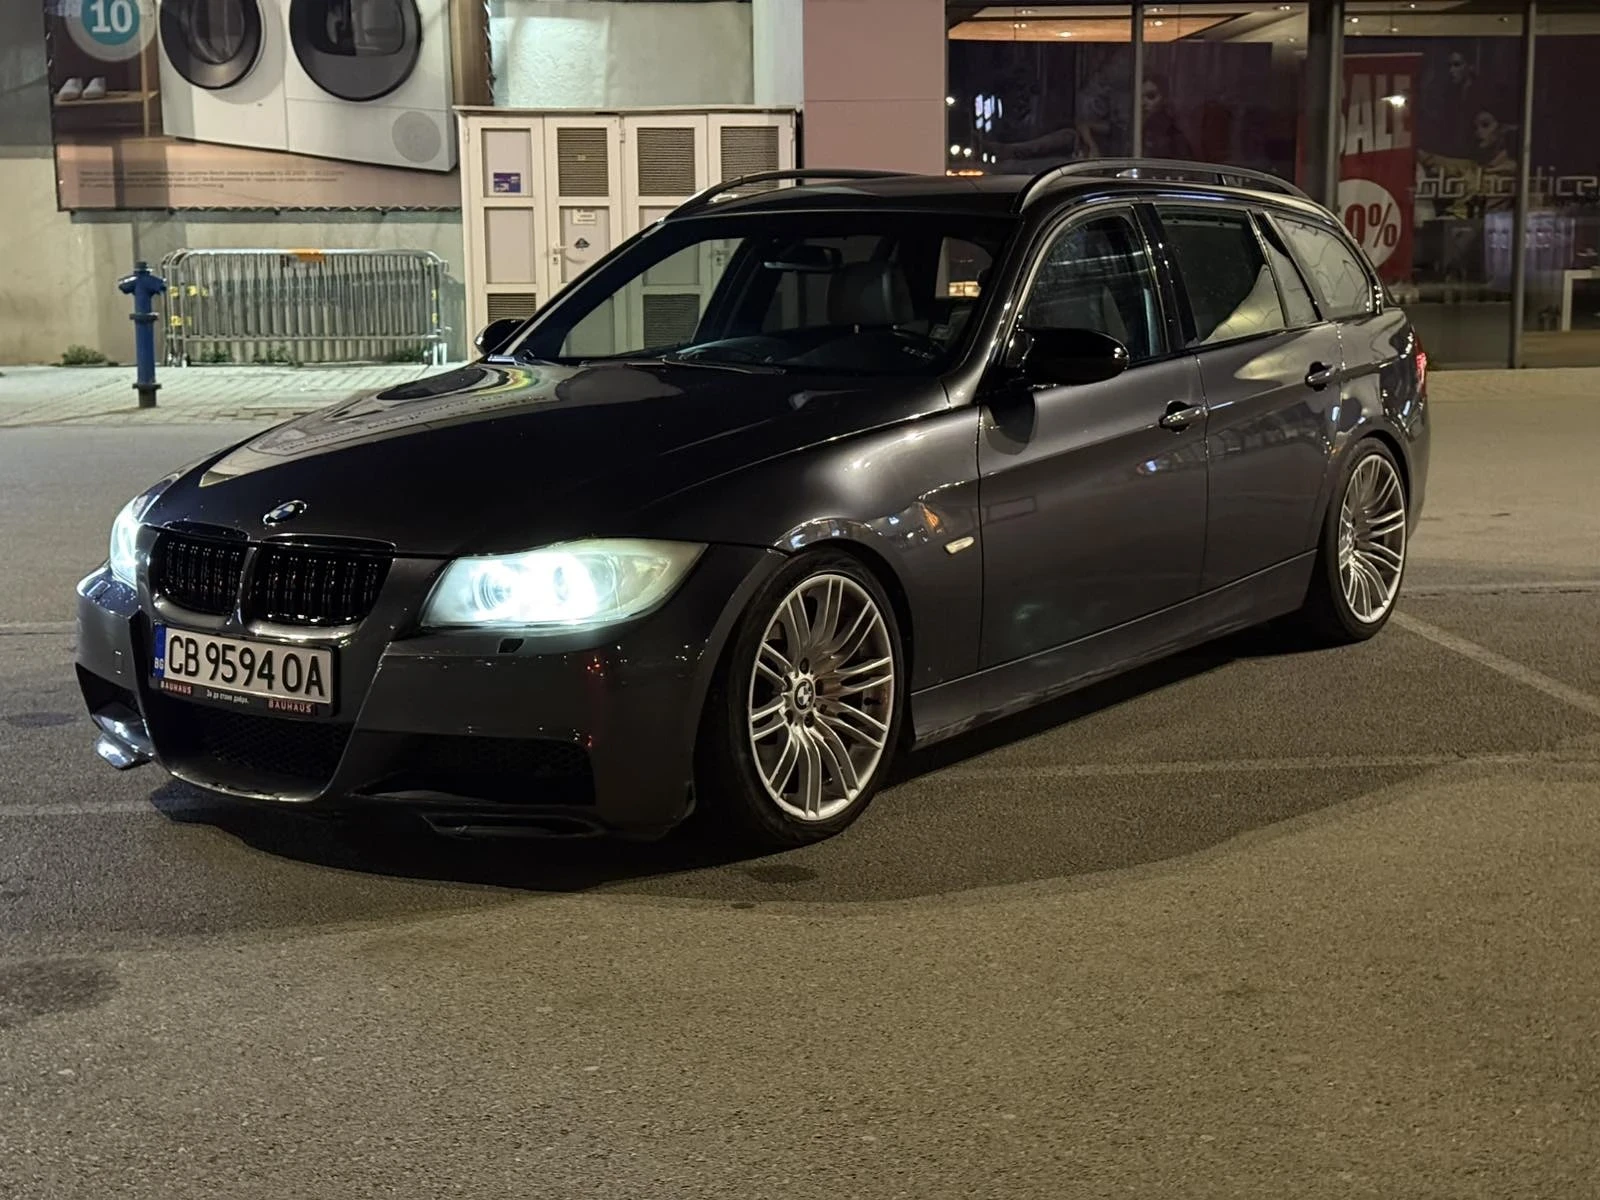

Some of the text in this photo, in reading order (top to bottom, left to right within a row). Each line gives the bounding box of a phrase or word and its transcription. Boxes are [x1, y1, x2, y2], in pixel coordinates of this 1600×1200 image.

[89, 0, 133, 33] 10
[1340, 73, 1412, 156] ALE
[1341, 202, 1397, 249] 0%
[154, 657, 164, 670] BG
[160, 680, 192, 695] BAUHAUS
[268, 698, 312, 713] BAUHAUS
